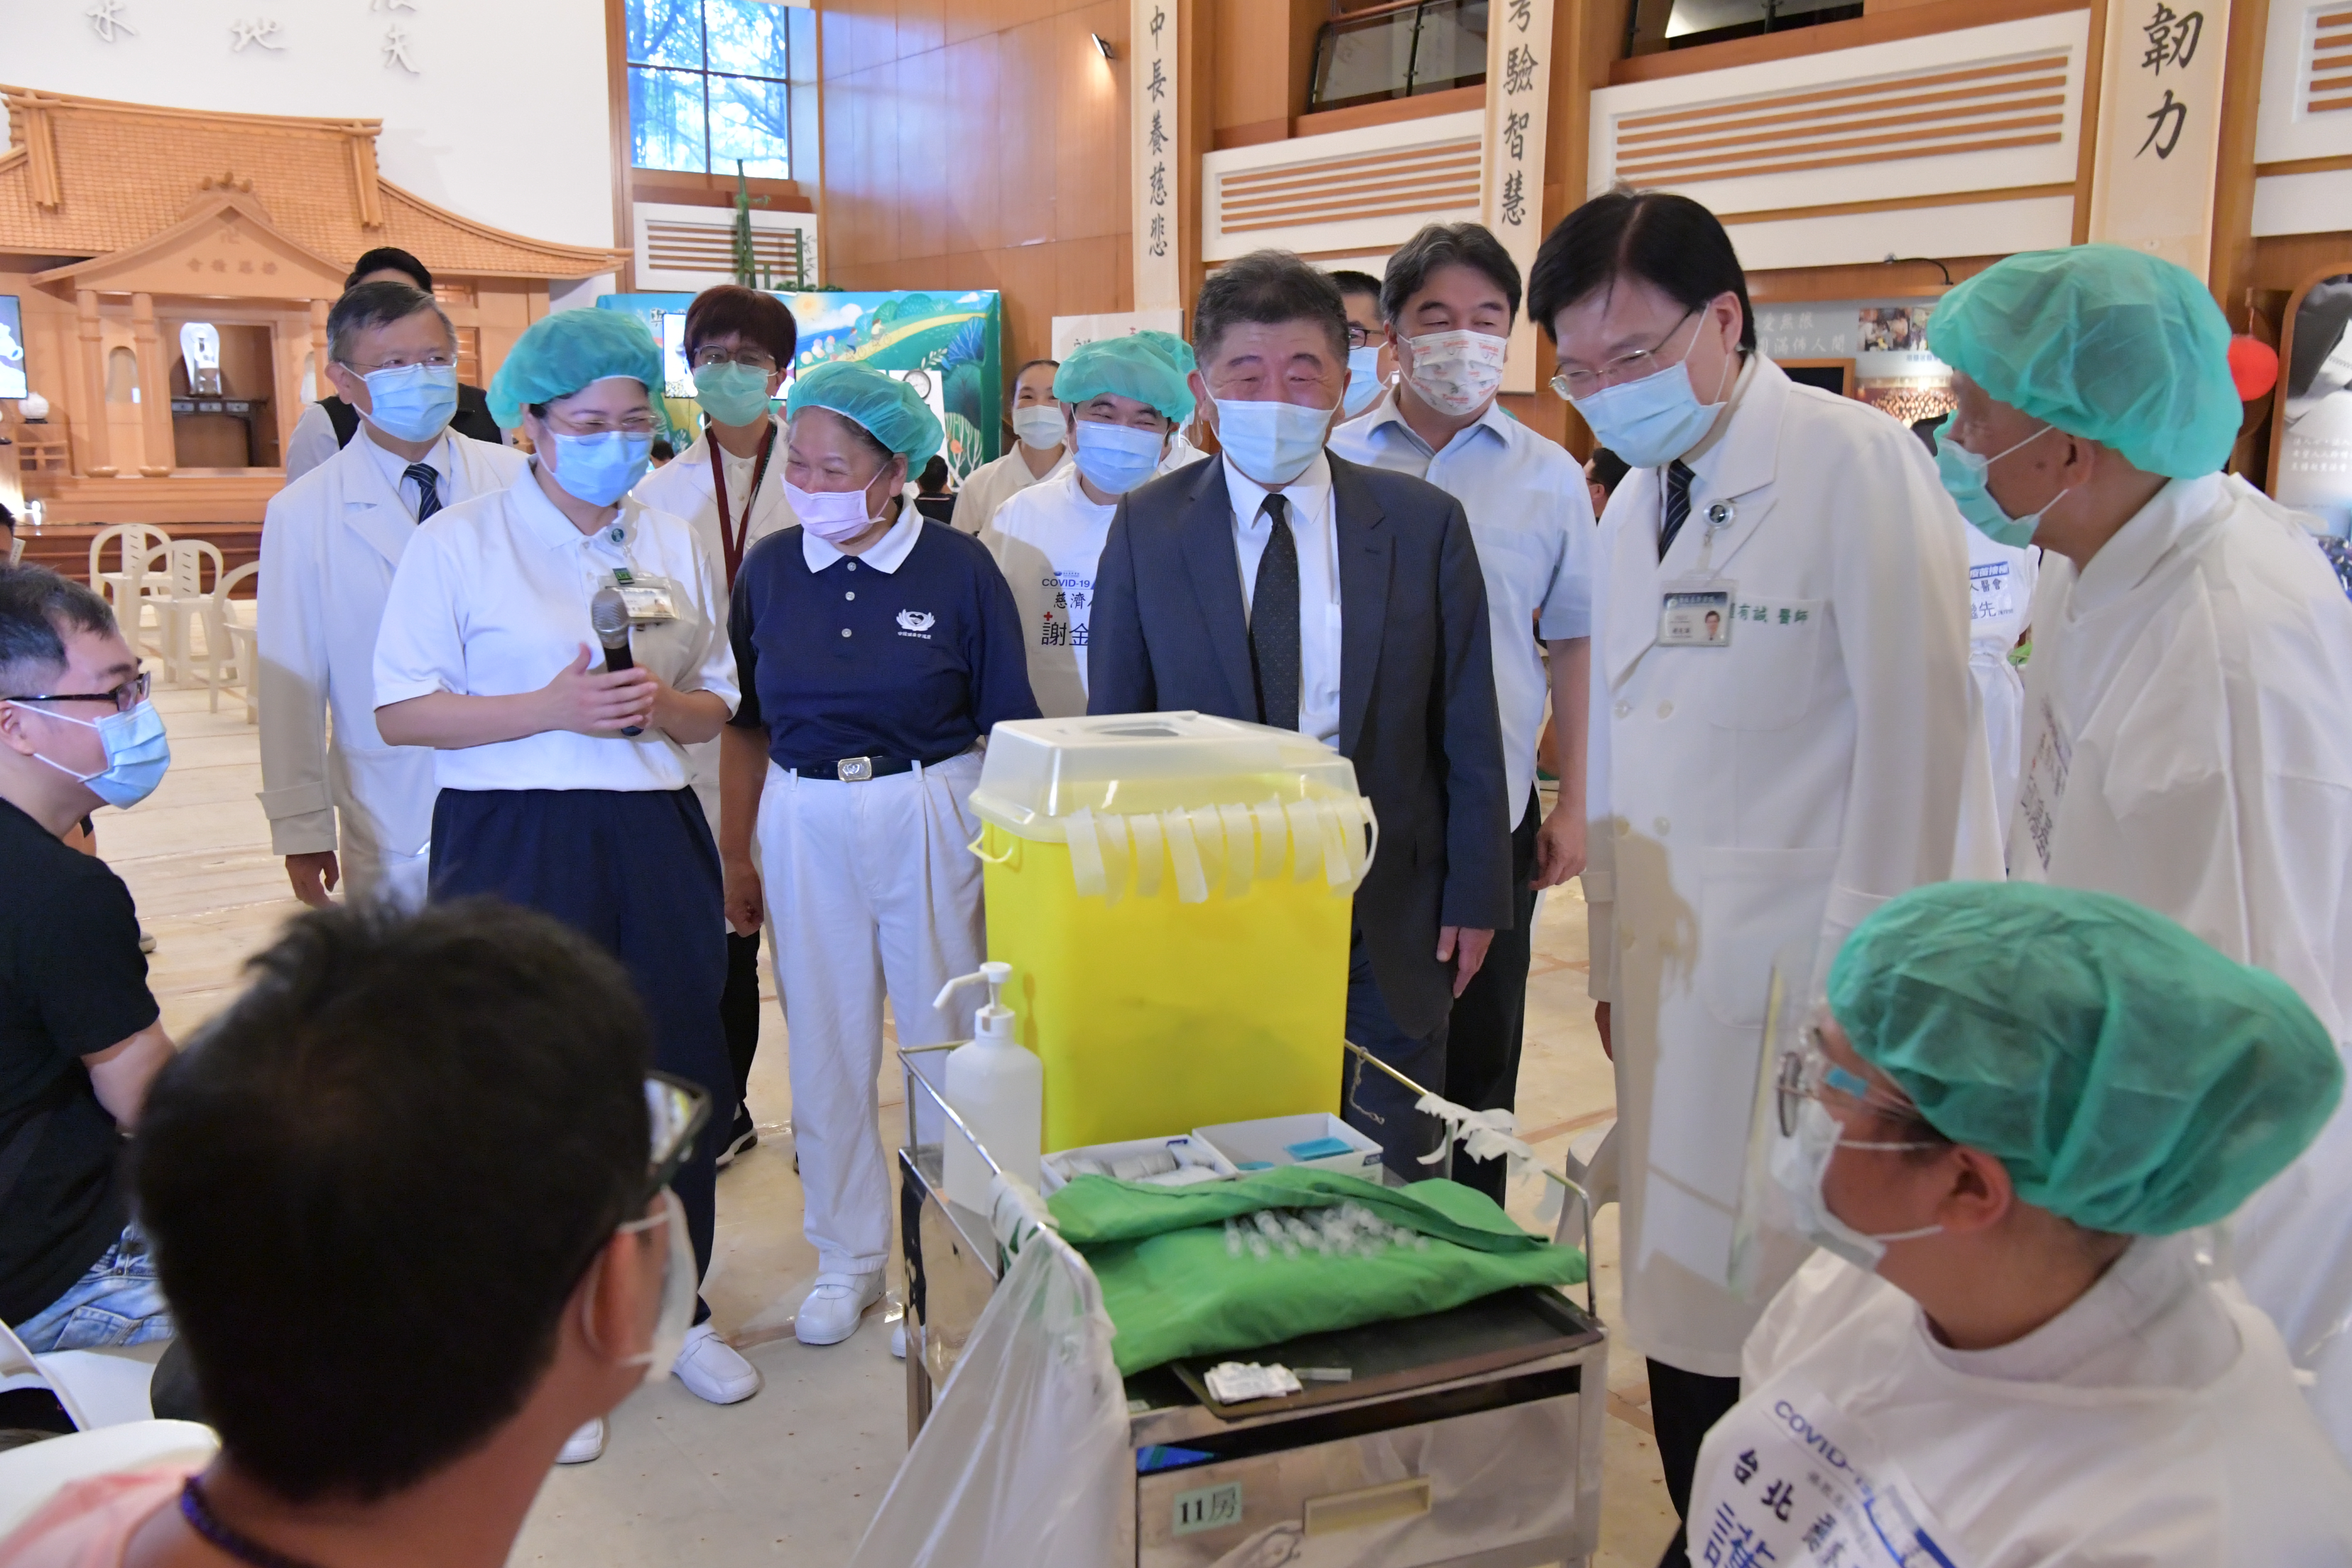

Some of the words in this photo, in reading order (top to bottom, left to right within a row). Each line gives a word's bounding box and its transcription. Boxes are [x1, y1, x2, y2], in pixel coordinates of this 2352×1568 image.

[2134, 2, 2204, 160] 韌力
[1147, 5, 1168, 257] 中長養慈悲
[1042, 578, 1090, 588] COVID-19
[1054, 591, 1092, 610] 慈濟
[1041, 622, 1089, 646] 謝金
[1181, 1486, 1236, 1524] 11房
